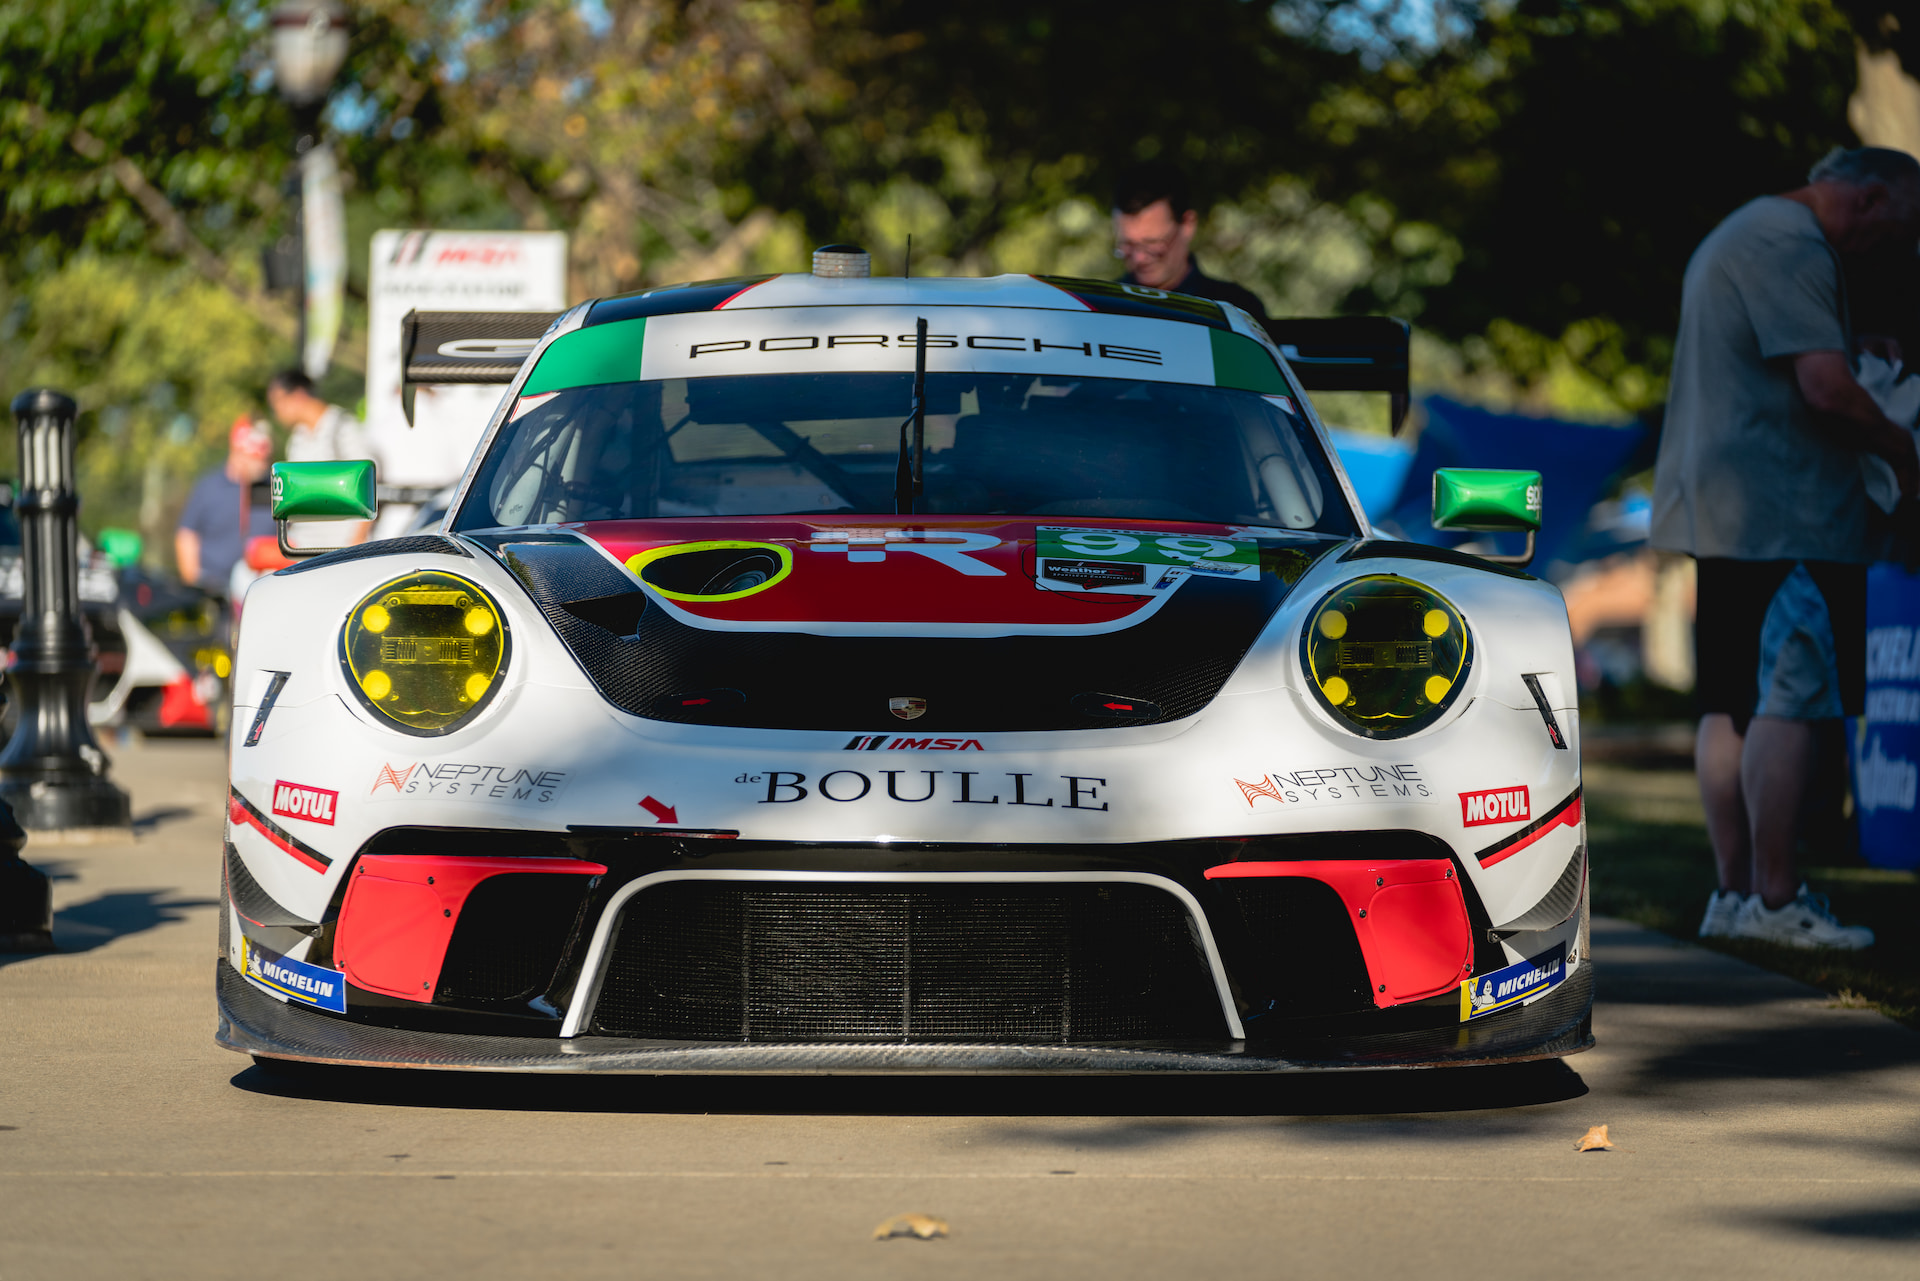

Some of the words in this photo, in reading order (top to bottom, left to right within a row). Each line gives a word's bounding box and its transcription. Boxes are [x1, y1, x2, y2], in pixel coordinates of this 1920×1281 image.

[690, 334, 1164, 366] PORSCHE
[1048, 565, 1141, 577] WeatherTech
[887, 737, 985, 751] IMSA
[413, 762, 567, 789] NEPTUNE
[758, 770, 1109, 811] BOULLE
[1272, 764, 1423, 789] NEPTUNE
[274, 785, 334, 821] MOTUL
[1465, 789, 1529, 823] MOTUL
[262, 960, 334, 998] MICHELIN
[1496, 957, 1561, 998] MICHELIN
